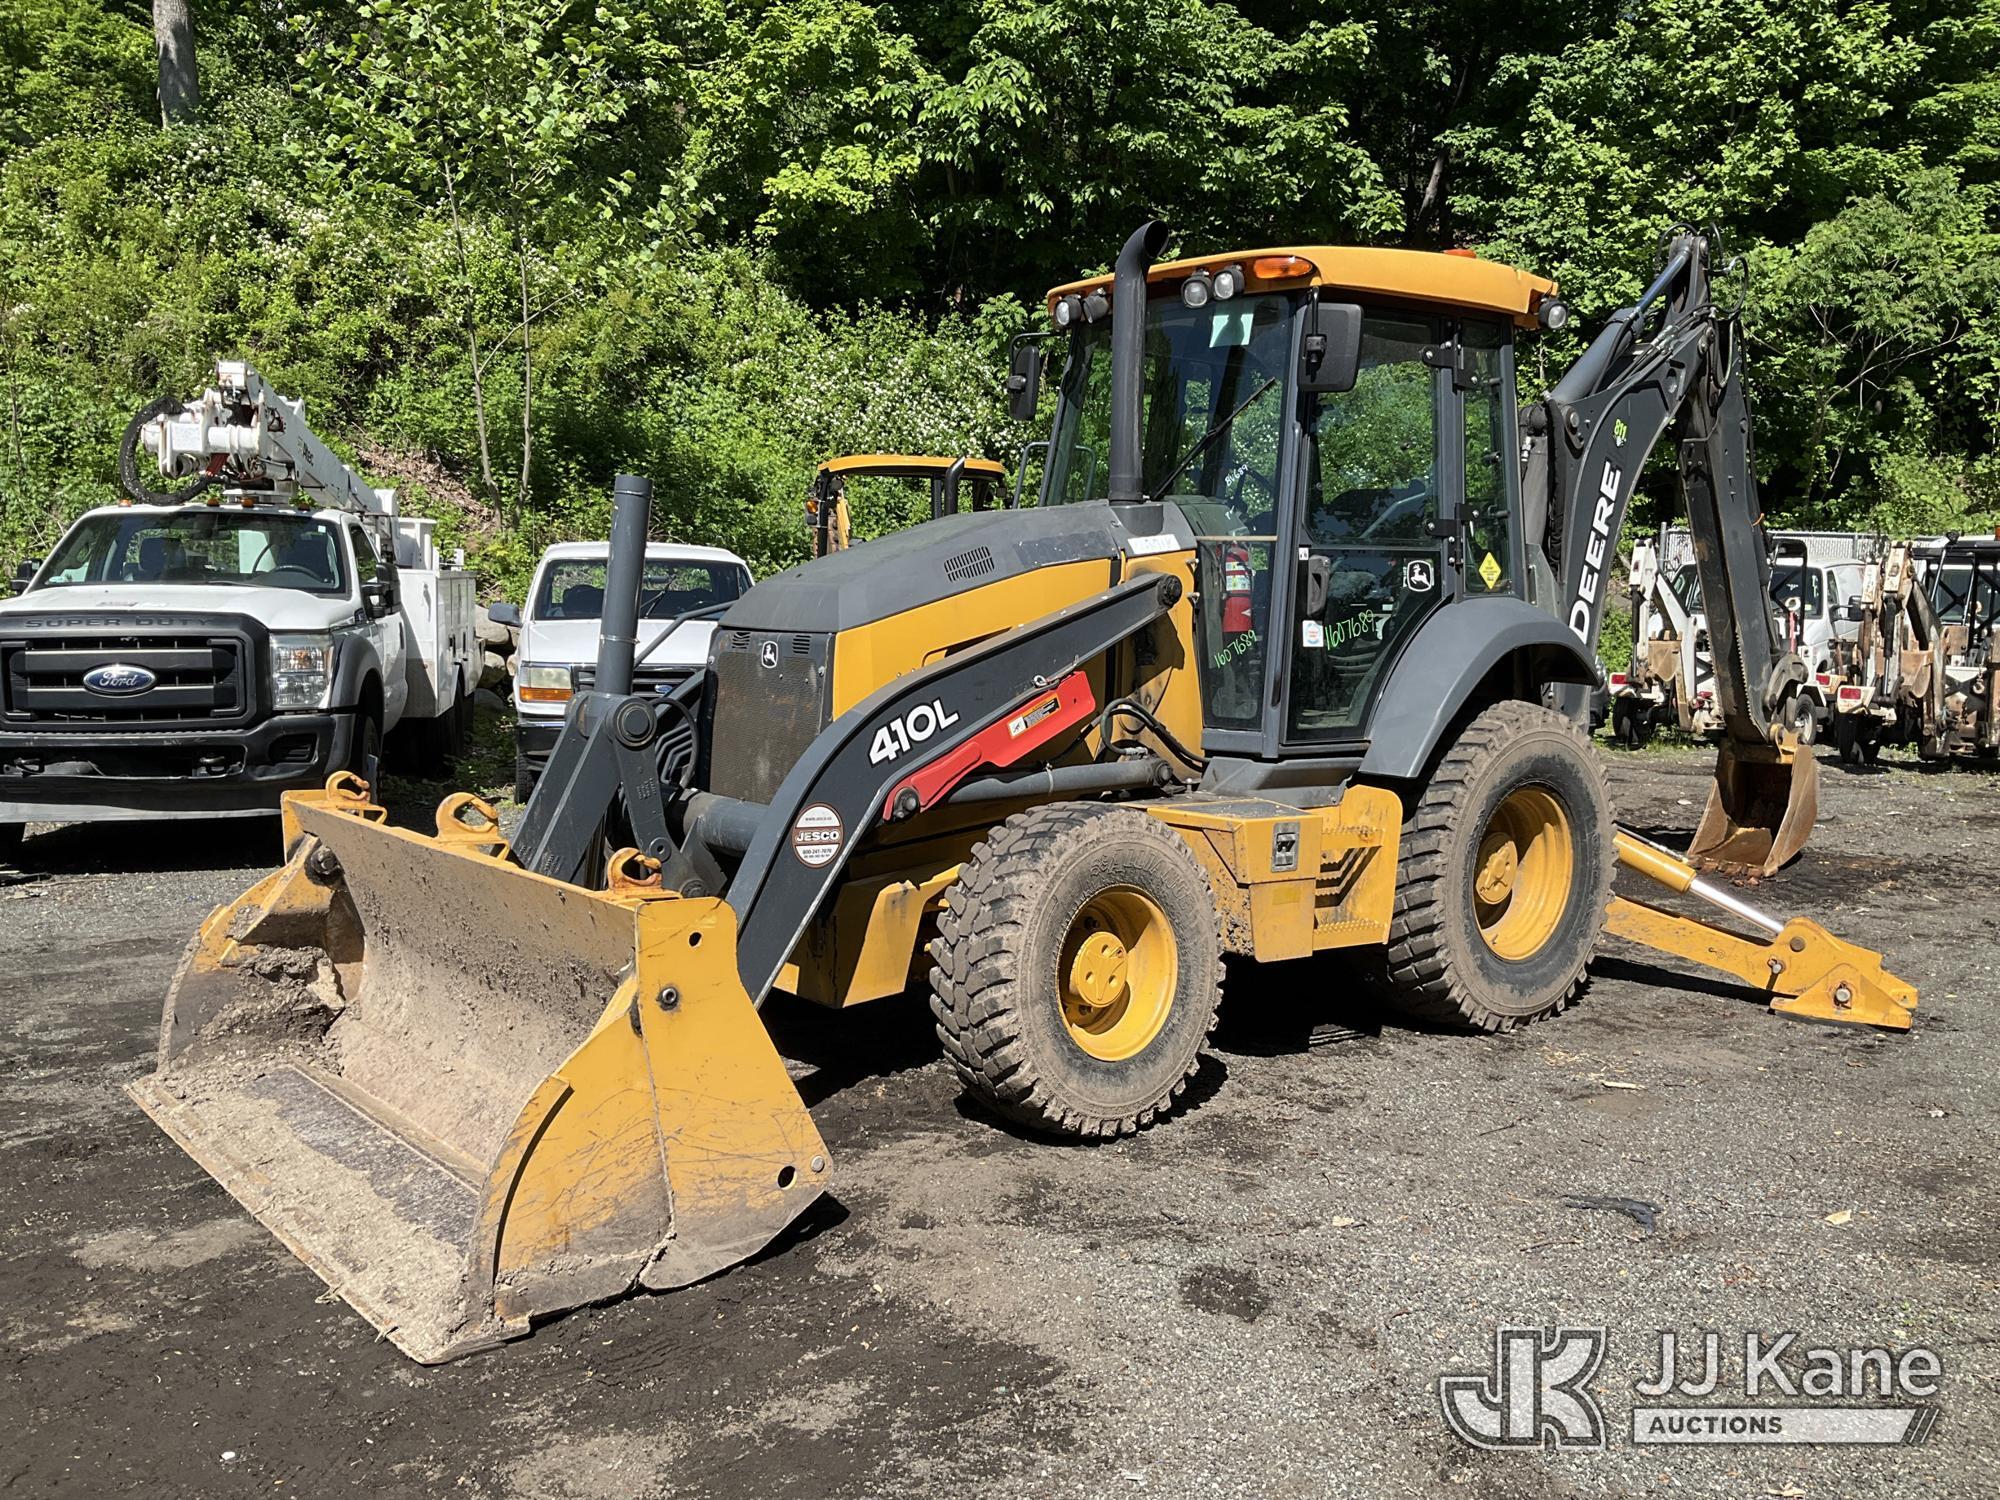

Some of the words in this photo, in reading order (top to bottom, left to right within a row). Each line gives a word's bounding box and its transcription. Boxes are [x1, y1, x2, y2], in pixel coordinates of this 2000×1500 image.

[1569, 459, 1622, 645] DEERE
[25, 618, 121, 628] SUPER
[135, 617, 213, 627] DUTY
[1325, 609, 1375, 650] 1607689
[1214, 630, 1258, 668] 1607689
[99, 671, 138, 687] Ford
[870, 698, 960, 766] 410L
[797, 831, 839, 841] JESCO
